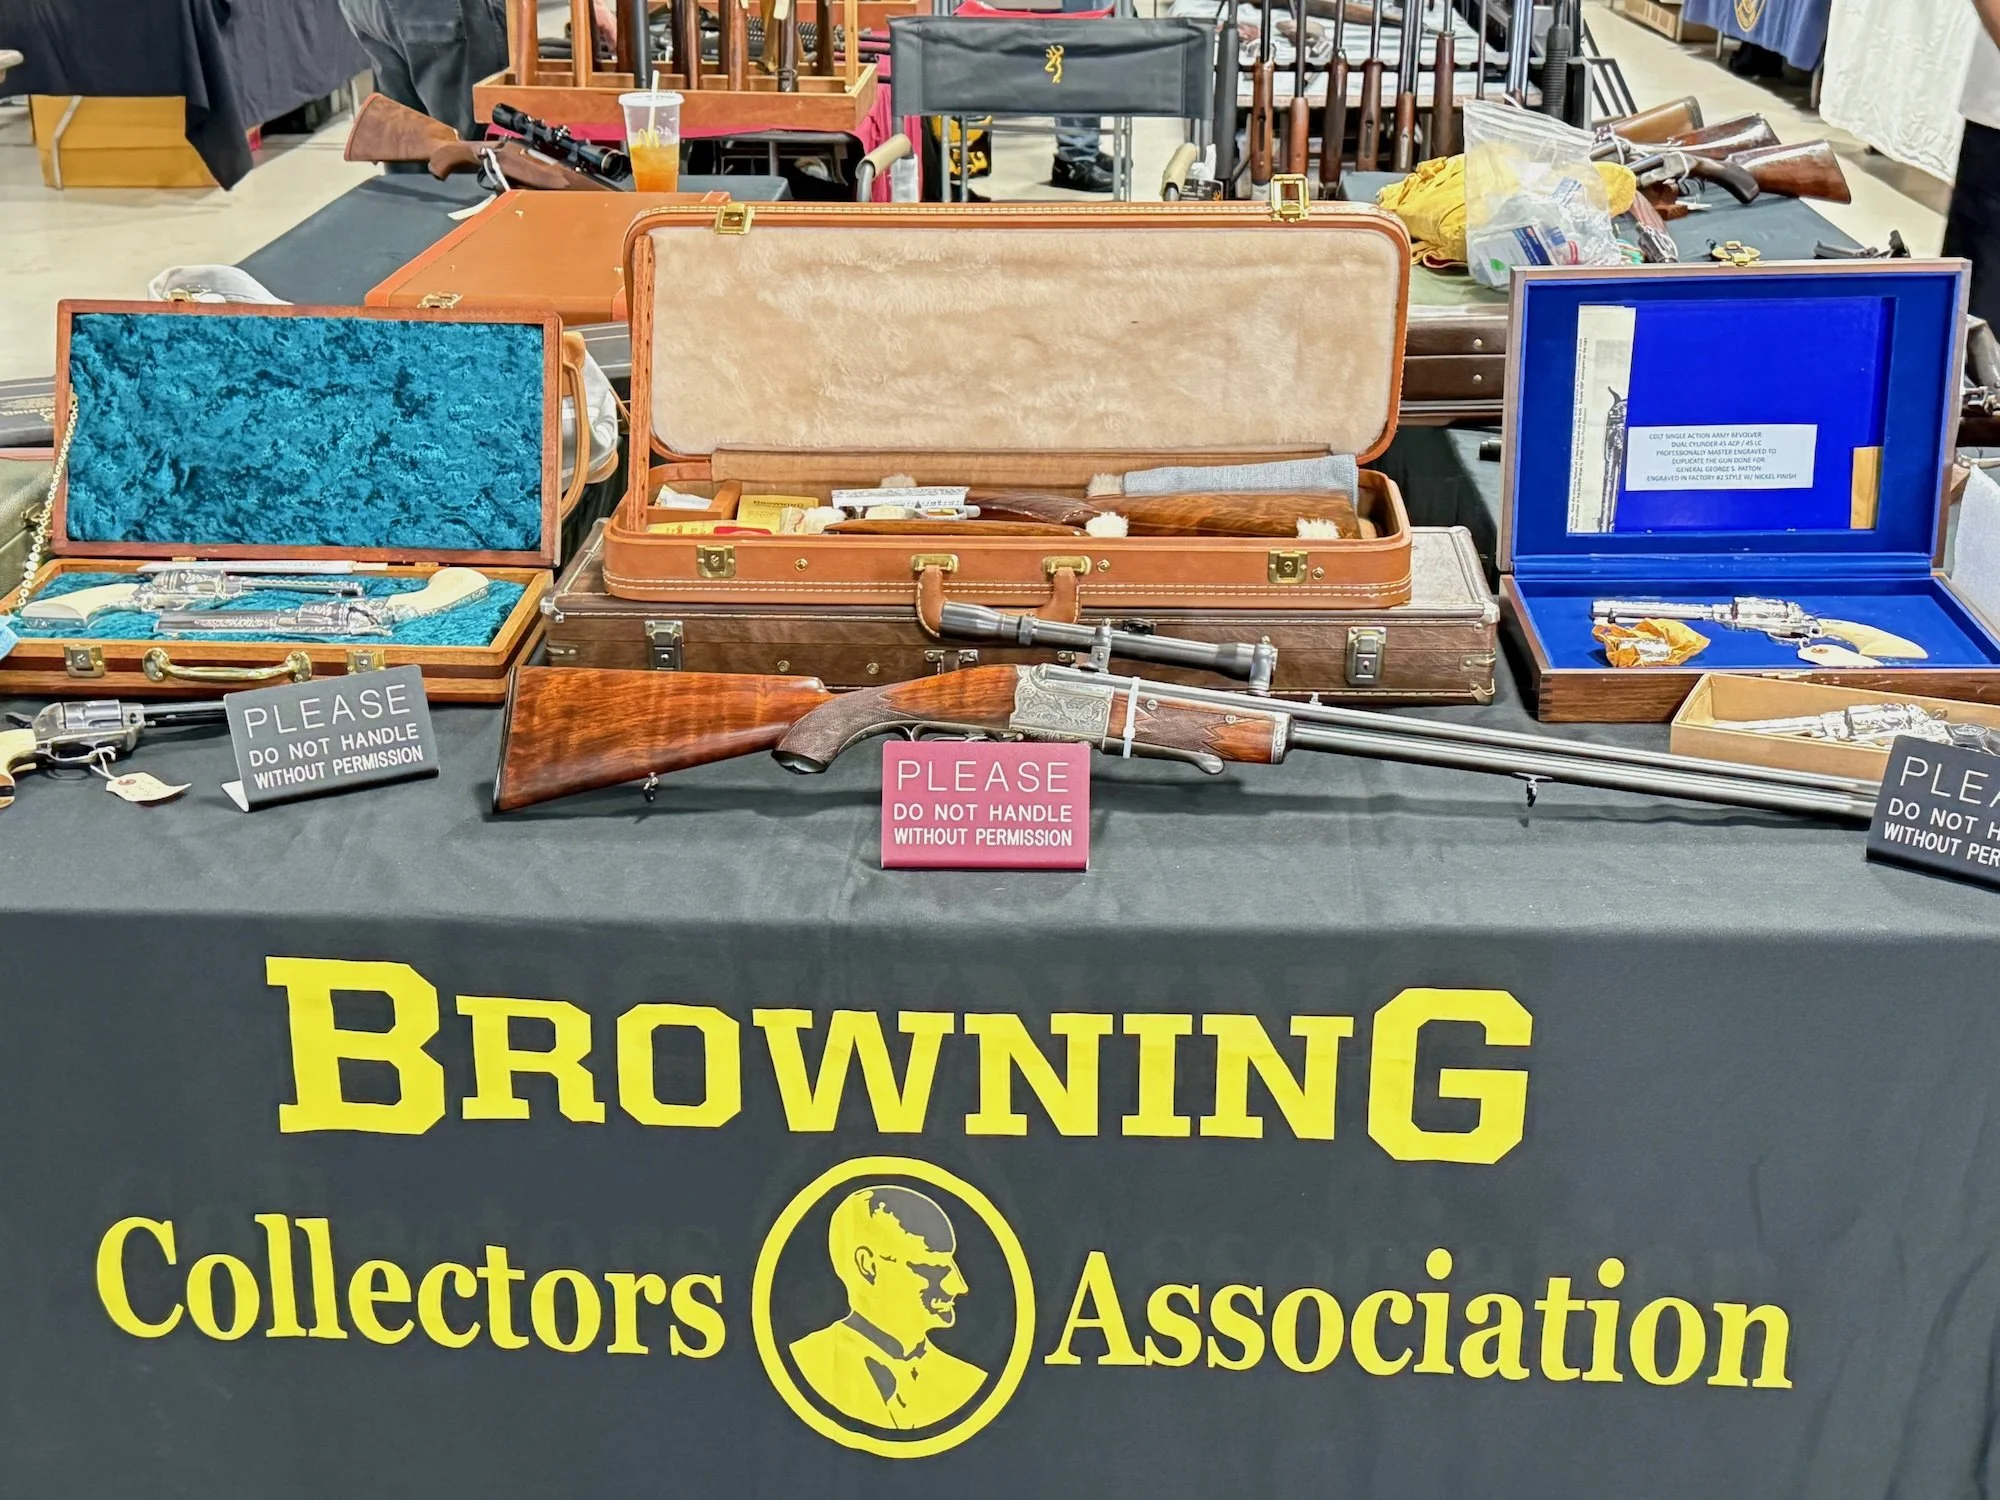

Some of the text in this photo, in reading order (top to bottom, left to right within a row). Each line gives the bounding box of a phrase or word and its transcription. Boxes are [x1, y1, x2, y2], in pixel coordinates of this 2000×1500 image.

[1743, 473, 1753, 481] W/
[1776, 472, 1797, 480] FINISH
[243, 684, 411, 739] PLEASE
[249, 722, 420, 768] DO NOT HANDLE
[253, 744, 424, 790] WITHOUT PERMISSION
[897, 760, 1070, 793] PLEASE
[893, 802, 1073, 823] DO NOT HANDLE
[1887, 797, 1920, 821] DO
[1929, 807, 1980, 835] NOT
[893, 827, 1073, 847] WITHOUT PERMISSION
[1883, 820, 1963, 857] WITHOUT
[265, 956, 1535, 1166] BROWNING
[95, 1212, 1794, 1390] Collectors Association
